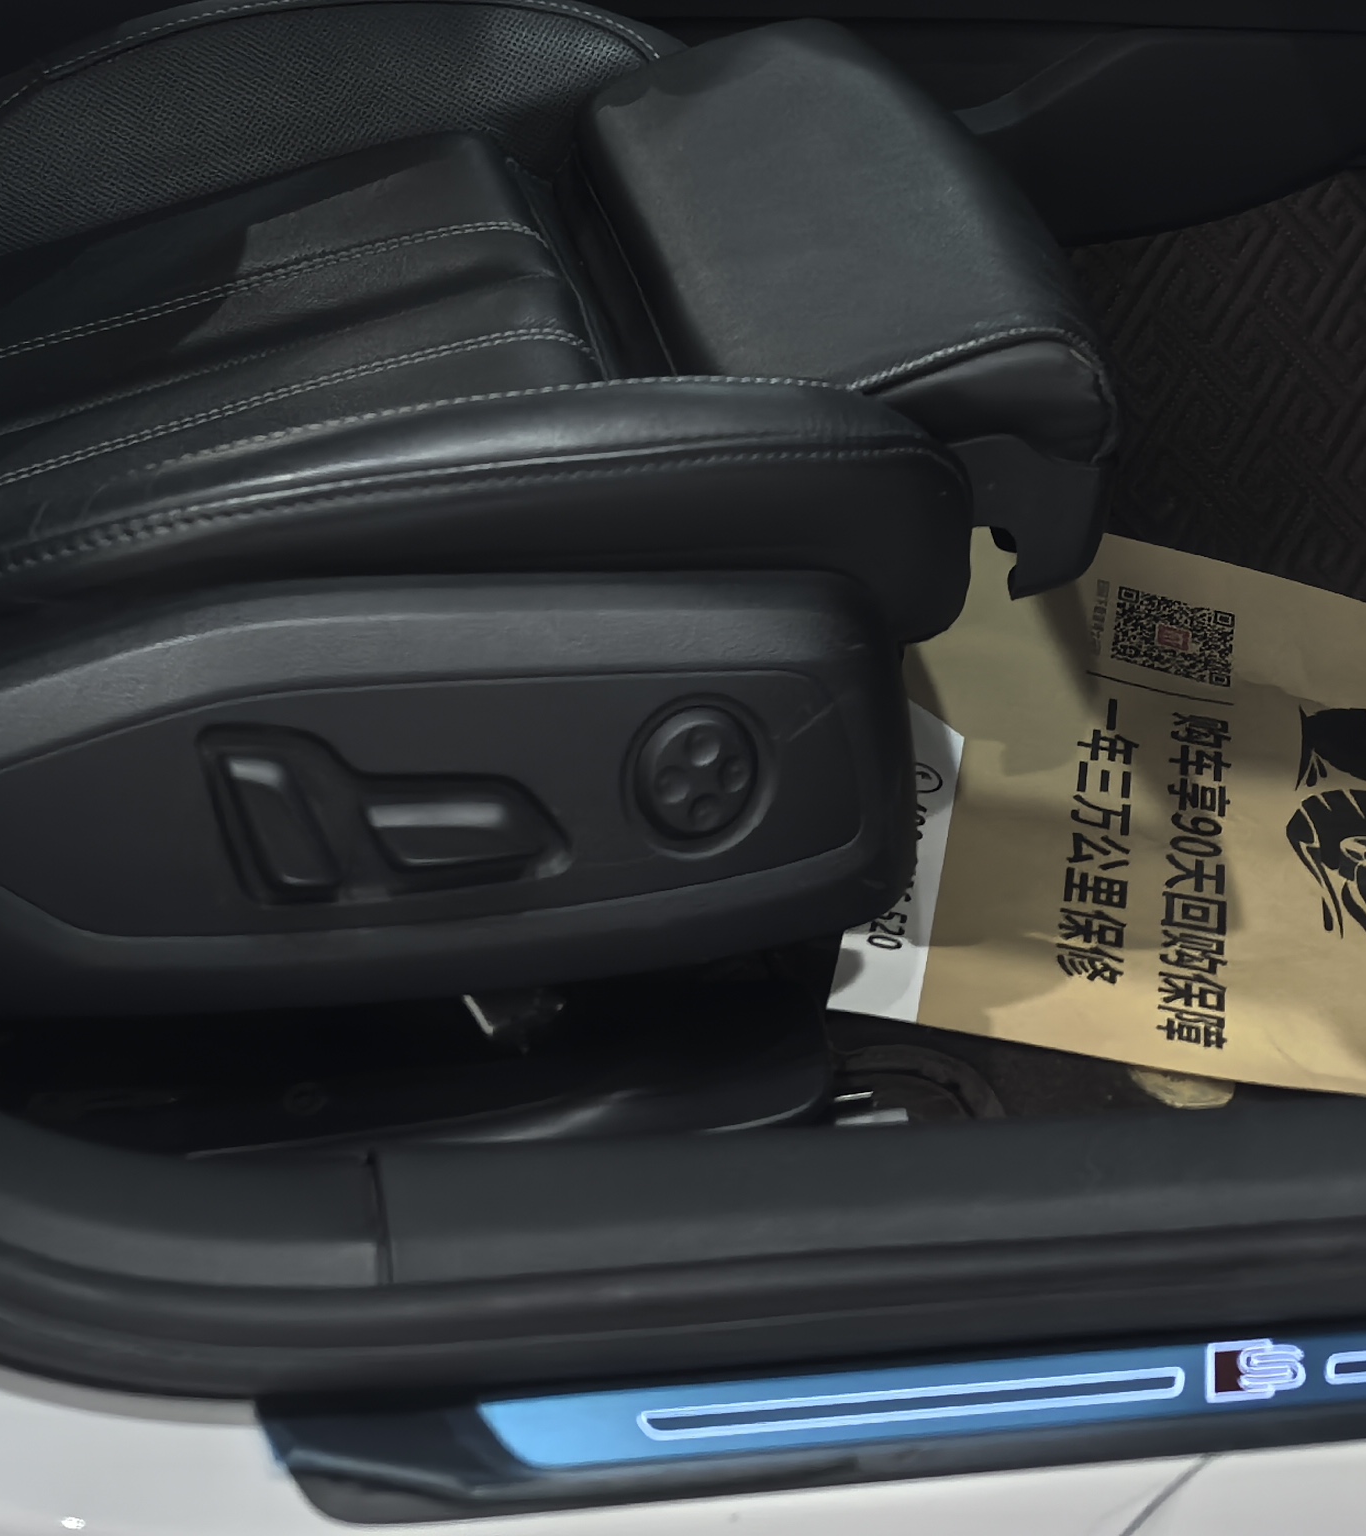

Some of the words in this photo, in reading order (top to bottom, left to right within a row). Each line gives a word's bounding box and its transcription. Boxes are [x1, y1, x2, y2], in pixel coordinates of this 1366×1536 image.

[1056, 698, 1140, 986] 一年三万公里保修
[1157, 711, 1232, 1051] 购车享90天回购保障
